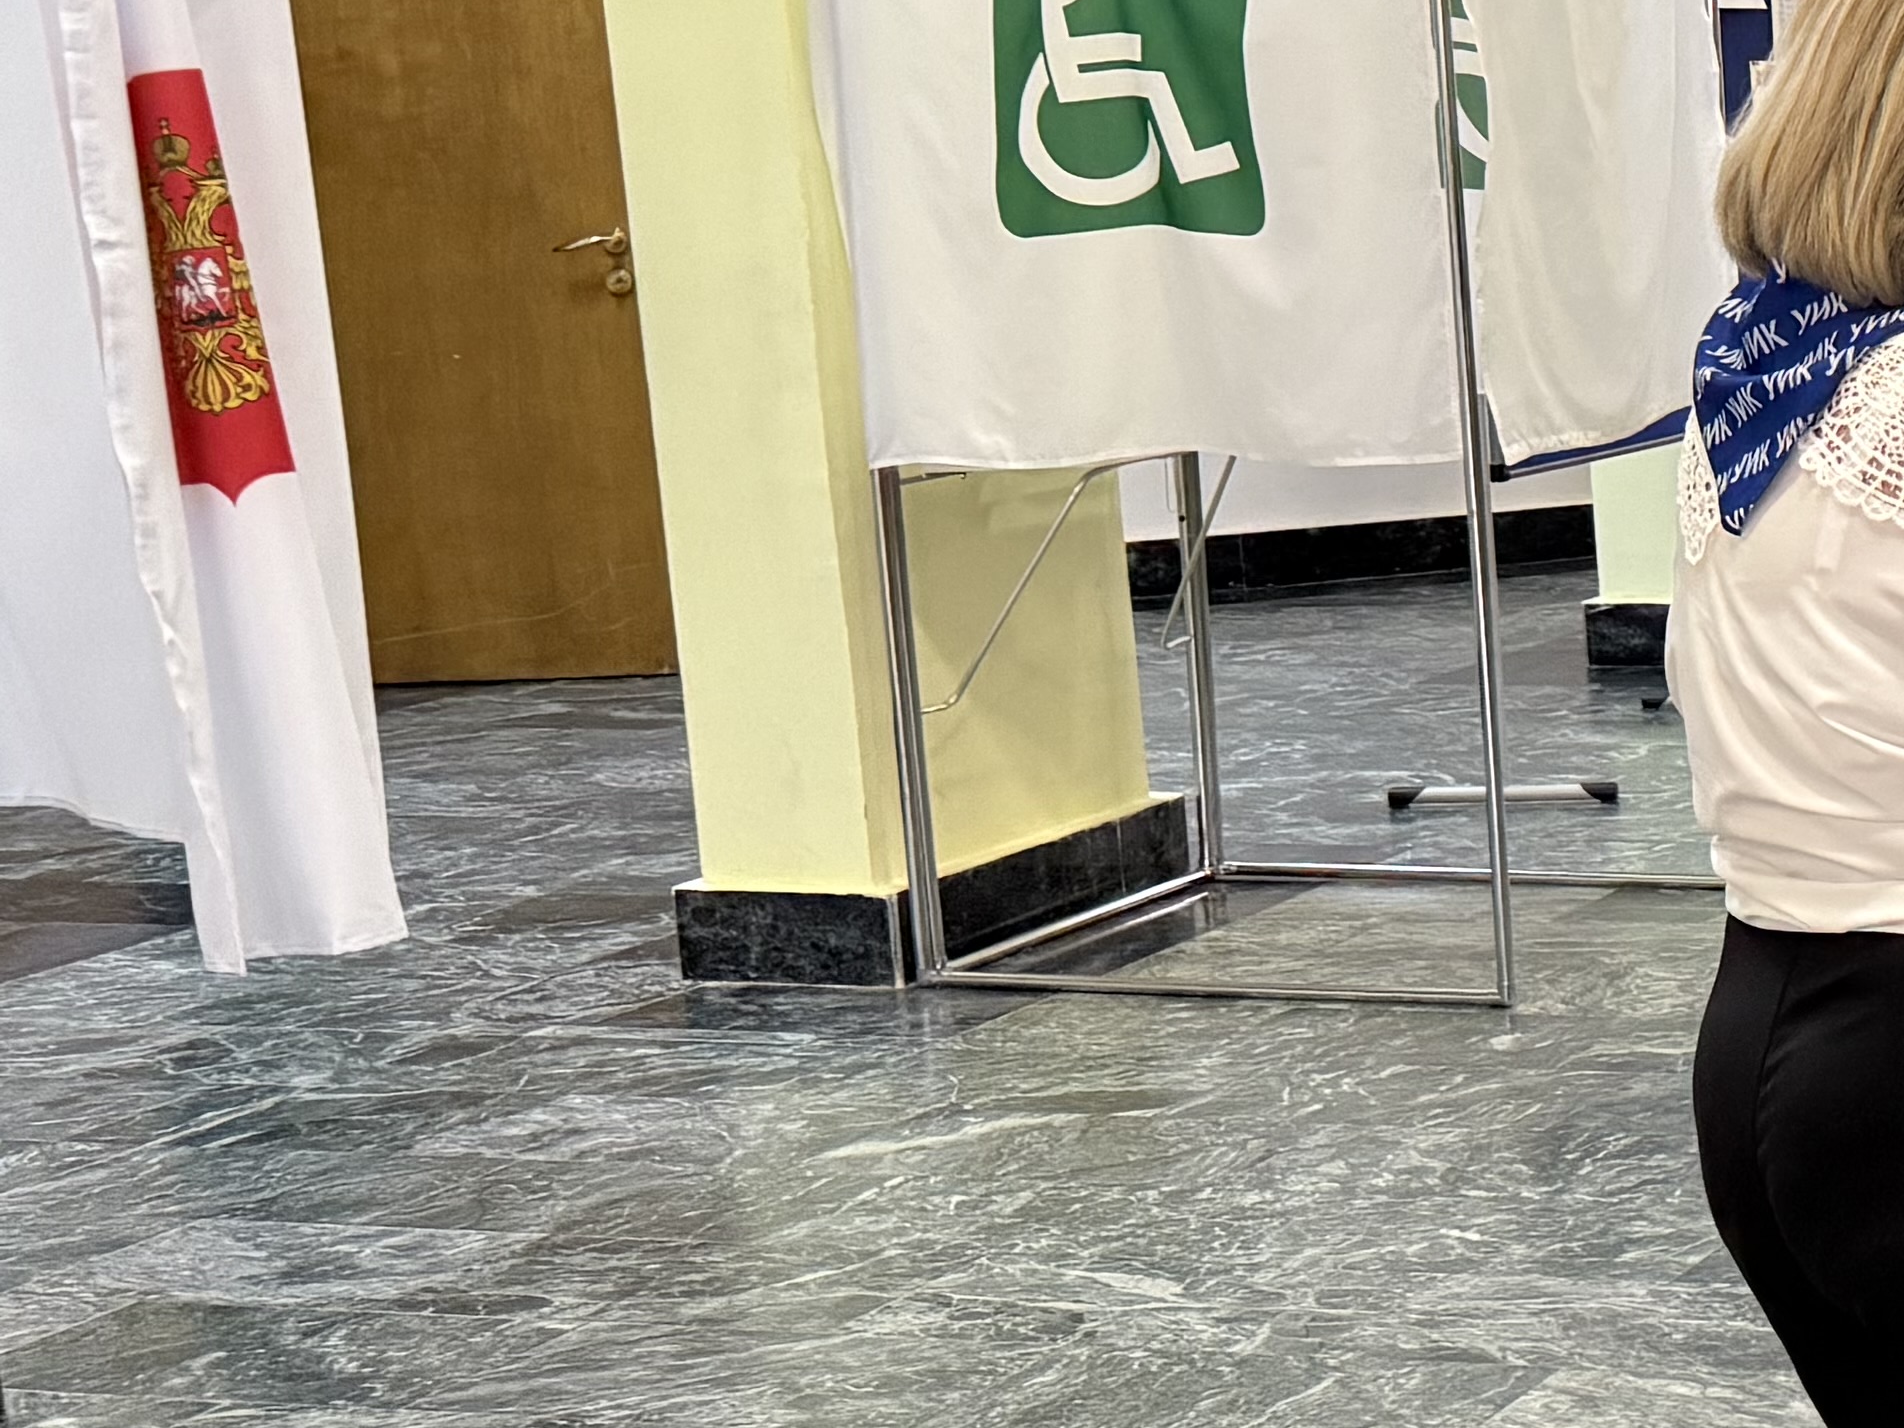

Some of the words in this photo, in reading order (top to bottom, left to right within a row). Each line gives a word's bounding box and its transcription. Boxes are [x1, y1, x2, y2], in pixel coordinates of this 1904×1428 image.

[1790, 291, 1849, 335] УИК
[1762, 362, 1813, 400] УИК
[1730, 438, 1771, 484] УИК
